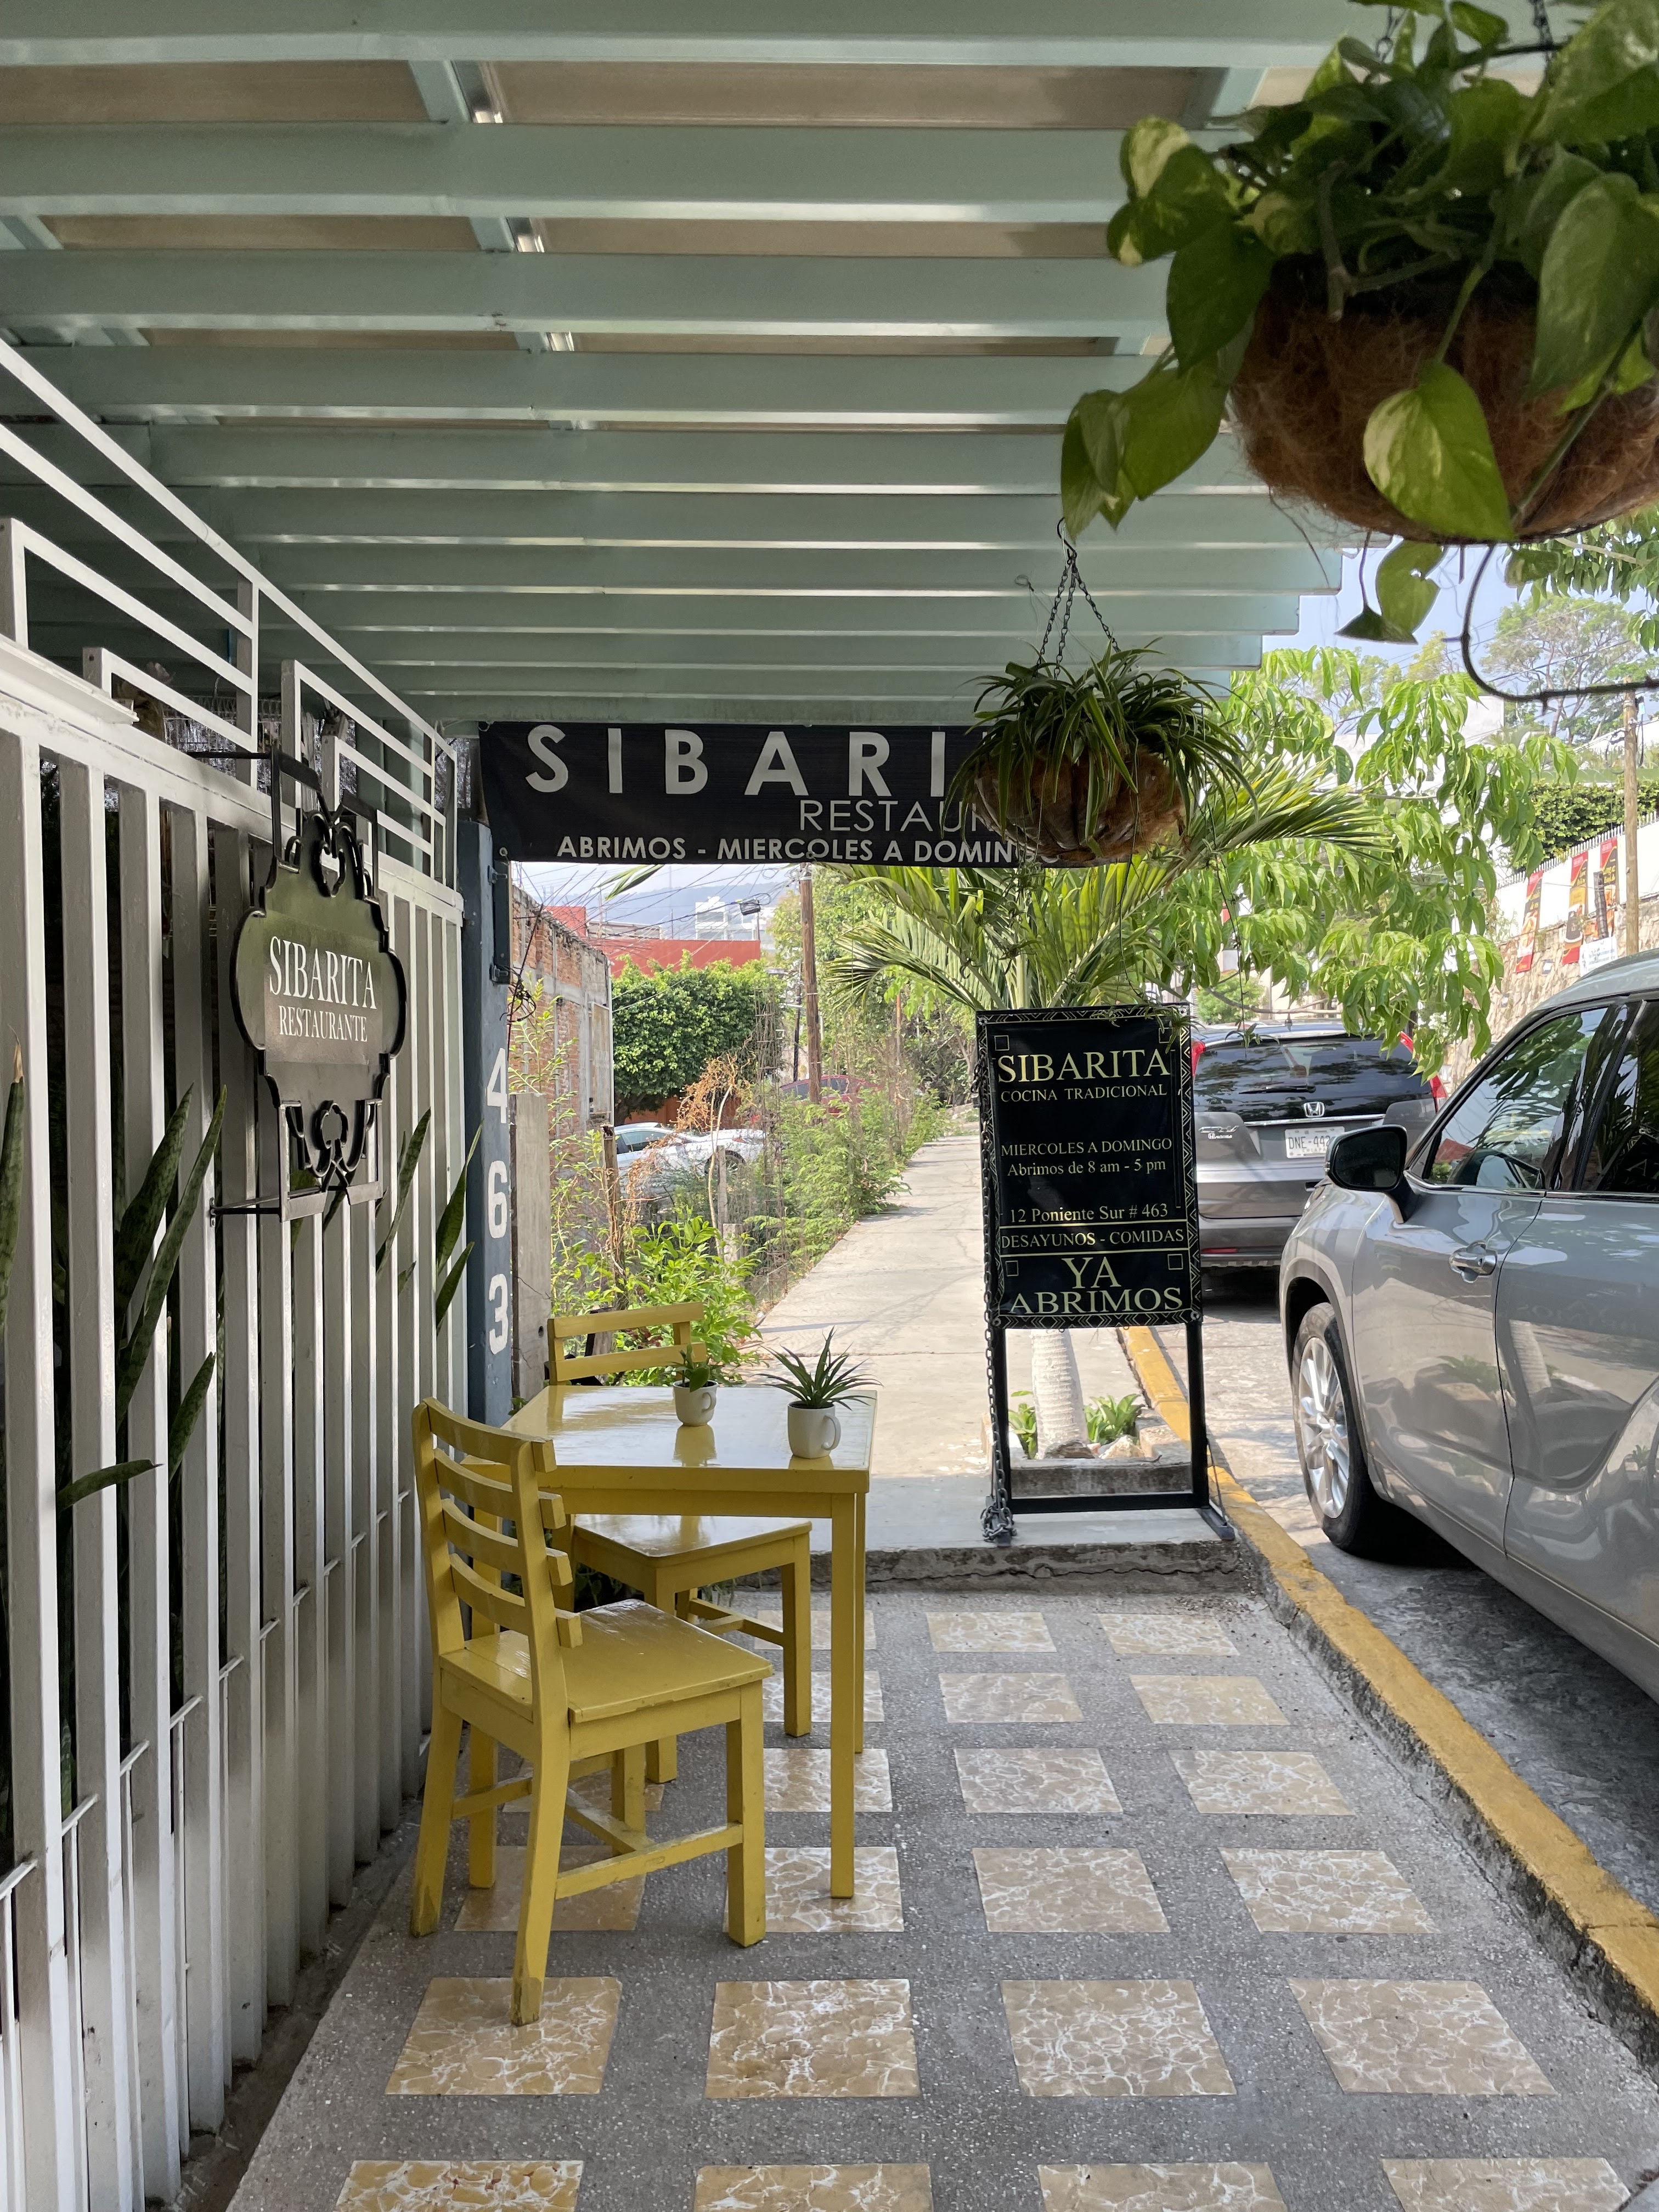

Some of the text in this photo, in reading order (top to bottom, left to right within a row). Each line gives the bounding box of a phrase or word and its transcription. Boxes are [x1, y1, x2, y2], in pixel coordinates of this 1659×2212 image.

[525, 724, 997, 797] SIBARI
[557, 836, 686, 860] ABRIMOS
[718, 838, 873, 861] MIERCOLES
[883, 840, 904, 862] A
[915, 840, 1020, 863] DOMIN
[269, 936, 377, 1009] SIBARITA
[279, 1005, 368, 1043] RESTAURANTE
[998, 1048, 1171, 1083] SIBARITA
[1001, 1084, 1167, 1103] COCINA TRADICIONAL
[1001, 1138, 1172, 1156] MIERCOLES A DOMINGO
[1007, 1161, 1064, 1176] Abrimos
[1068, 1160, 1084, 1173] de
[1088, 1161, 1096, 1173] 8
[1100, 1163, 1120, 1173] am
[1135, 1159, 1142, 1172] 5
[1146, 1160, 1166, 1175] pm
[1011, 1210, 1026, 1223] 12
[1032, 1207, 1094, 1222] Poniente
[1099, 1205, 1125, 1220] Sur
[1002, 1233, 1096, 1249] DESAYUNOS
[1110, 1229, 1184, 1245] COMIDAS
[1062, 1256, 1121, 1289] YA
[1009, 1287, 1183, 1314] ABRIMOS
